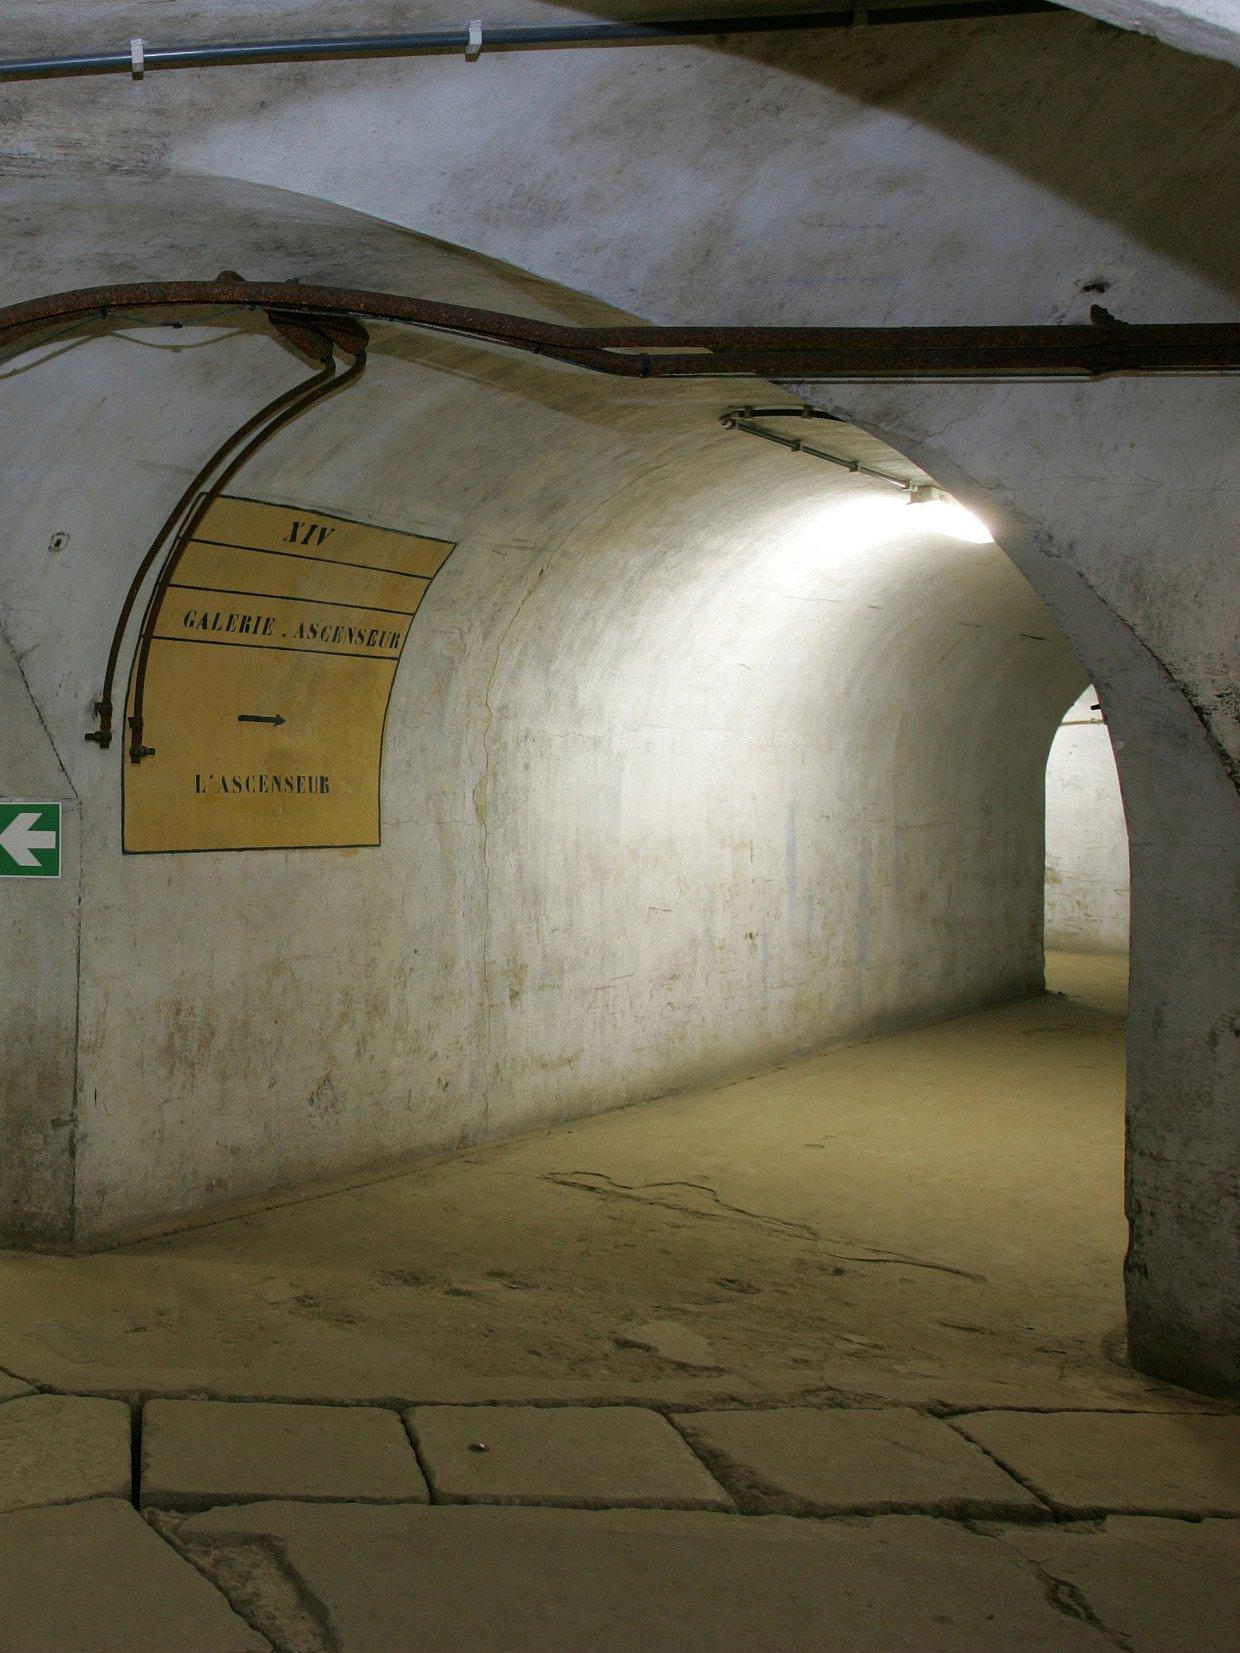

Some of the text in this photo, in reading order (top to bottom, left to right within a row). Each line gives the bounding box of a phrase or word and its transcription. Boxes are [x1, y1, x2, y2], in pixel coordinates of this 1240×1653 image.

[282, 521, 335, 546] XIV
[292, 622, 401, 649] ASCENSEUR
[195, 774, 331, 794] L'ASCENSEUR
